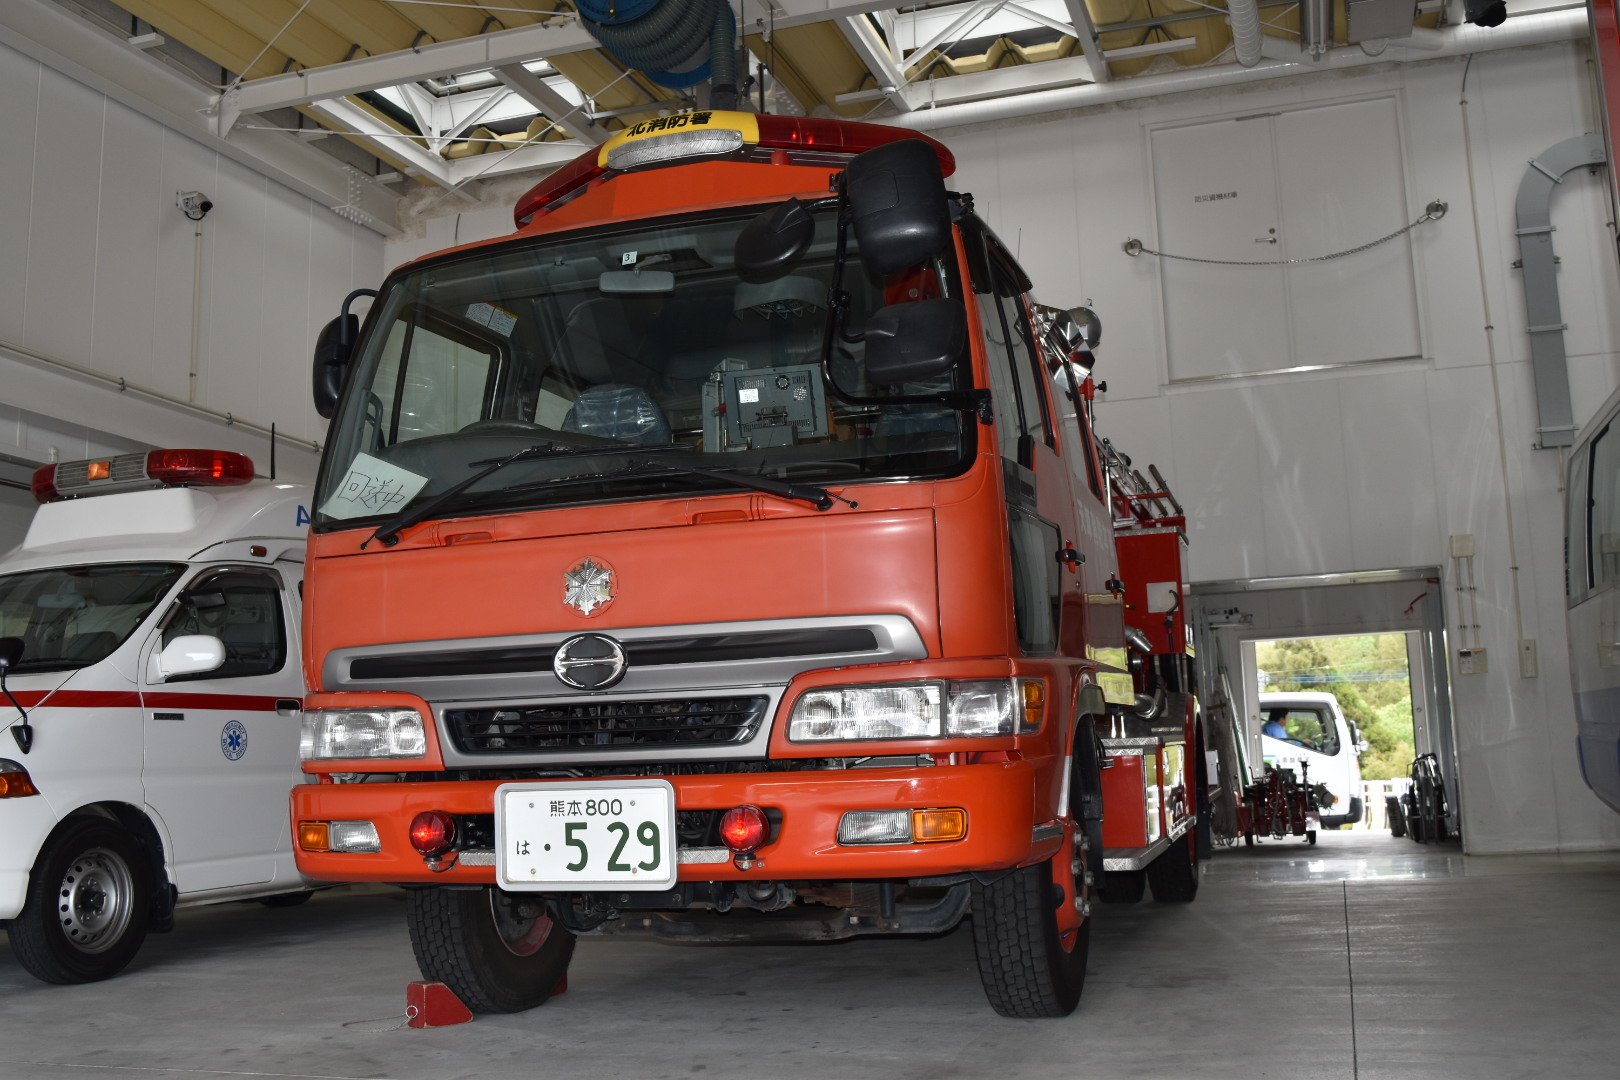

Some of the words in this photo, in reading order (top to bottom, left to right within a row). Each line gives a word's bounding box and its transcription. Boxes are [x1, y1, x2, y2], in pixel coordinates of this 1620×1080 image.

[626, 112, 712, 137] 北消防署
[624, 253, 631, 262] 3
[337, 470, 405, 512] 回送中
